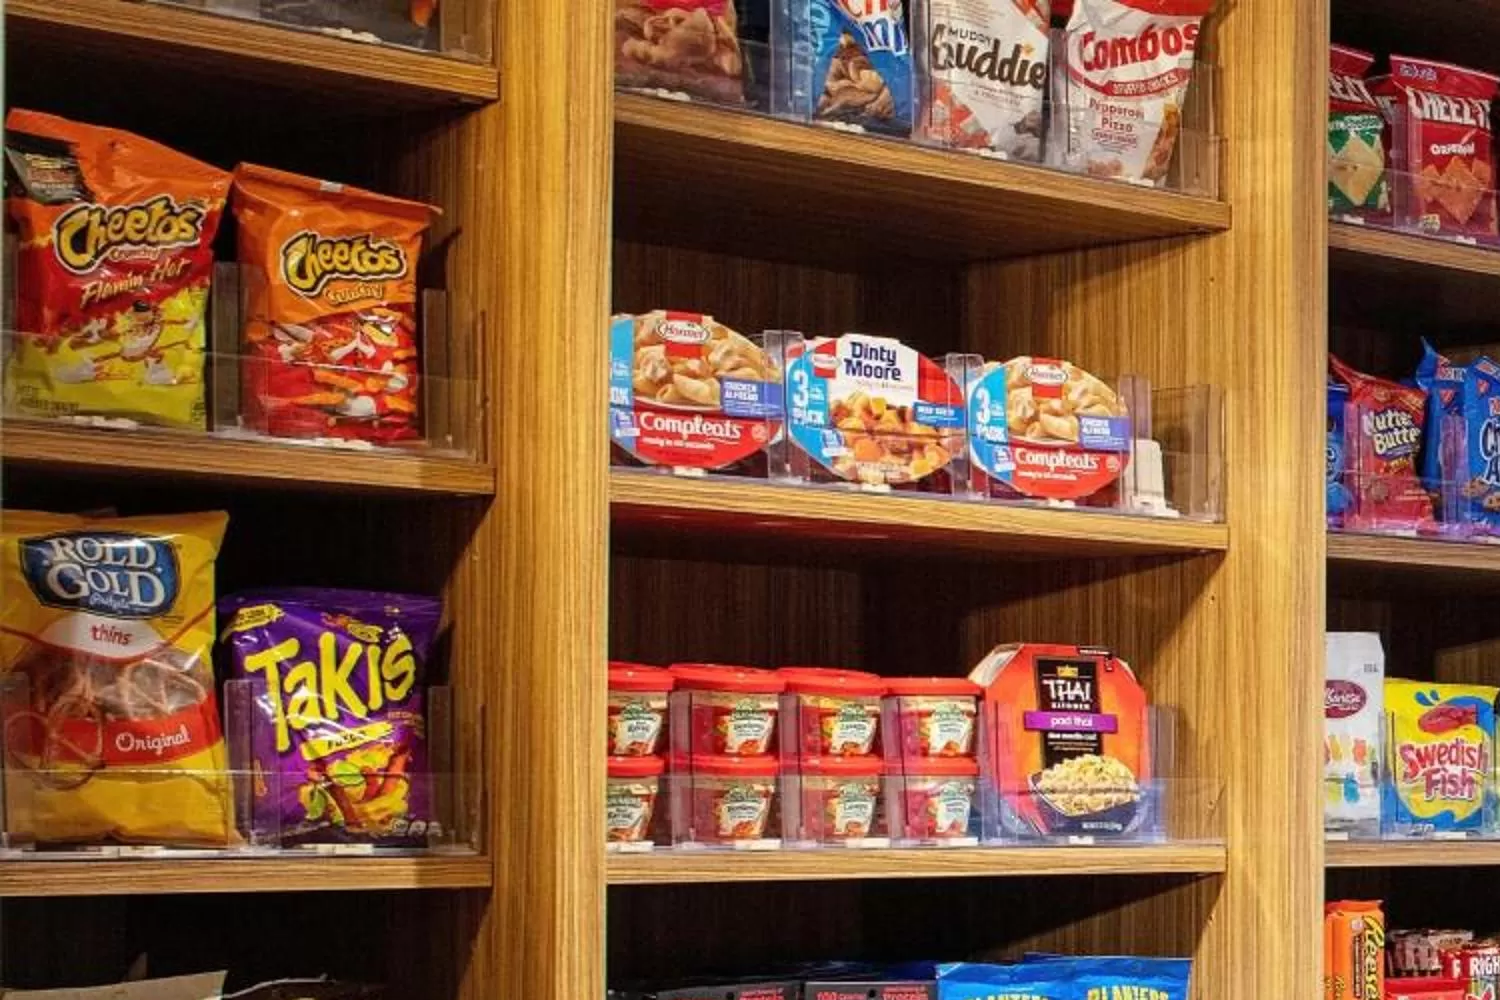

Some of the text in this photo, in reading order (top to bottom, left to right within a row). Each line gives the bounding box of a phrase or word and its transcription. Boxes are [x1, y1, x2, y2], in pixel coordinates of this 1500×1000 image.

[1101, 117, 1134, 133] Pizza
[56, 198, 206, 271] Cheetos
[150, 257, 190, 283] Hot
[281, 231, 405, 292] Cheetos
[850, 341, 898, 366] Dinty
[843, 358, 902, 381] Moore
[793, 369, 810, 406] 3
[975, 388, 991, 425] 3
[639, 411, 742, 440] Compleats
[1014, 447, 1098, 473] Compleats
[47, 537, 157, 568] ROLD
[47, 562, 165, 607] GOLD
[90, 623, 133, 646] thins
[1041, 679, 1093, 702] THAI
[115, 723, 192, 756] Original
[1399, 737, 1488, 782] Swedish
[1423, 766, 1477, 800] Fish
